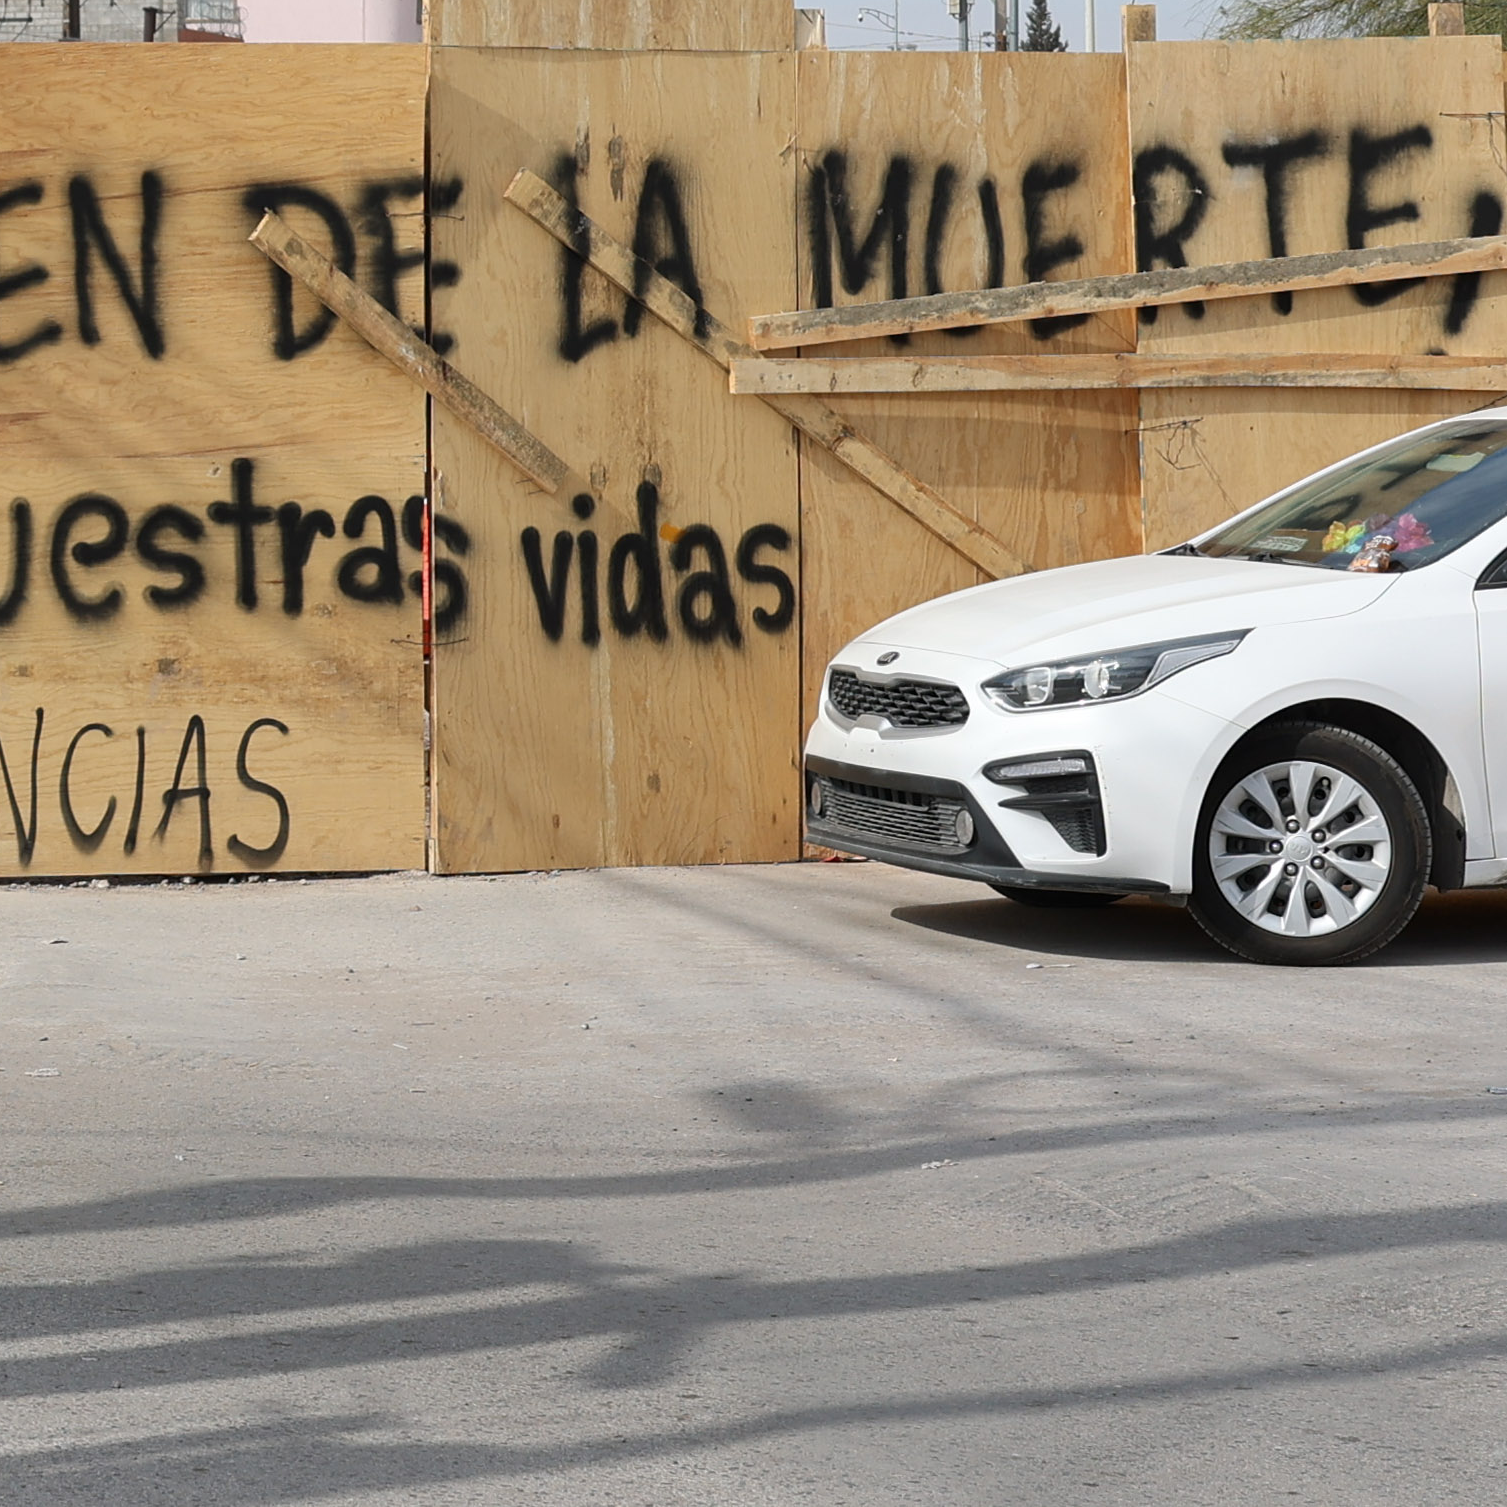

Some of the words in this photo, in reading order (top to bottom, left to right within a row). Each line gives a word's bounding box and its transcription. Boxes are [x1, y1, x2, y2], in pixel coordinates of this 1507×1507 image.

[242, 173, 465, 361] DE
[550, 143, 710, 362] LA
[520, 480, 797, 649] vidas
